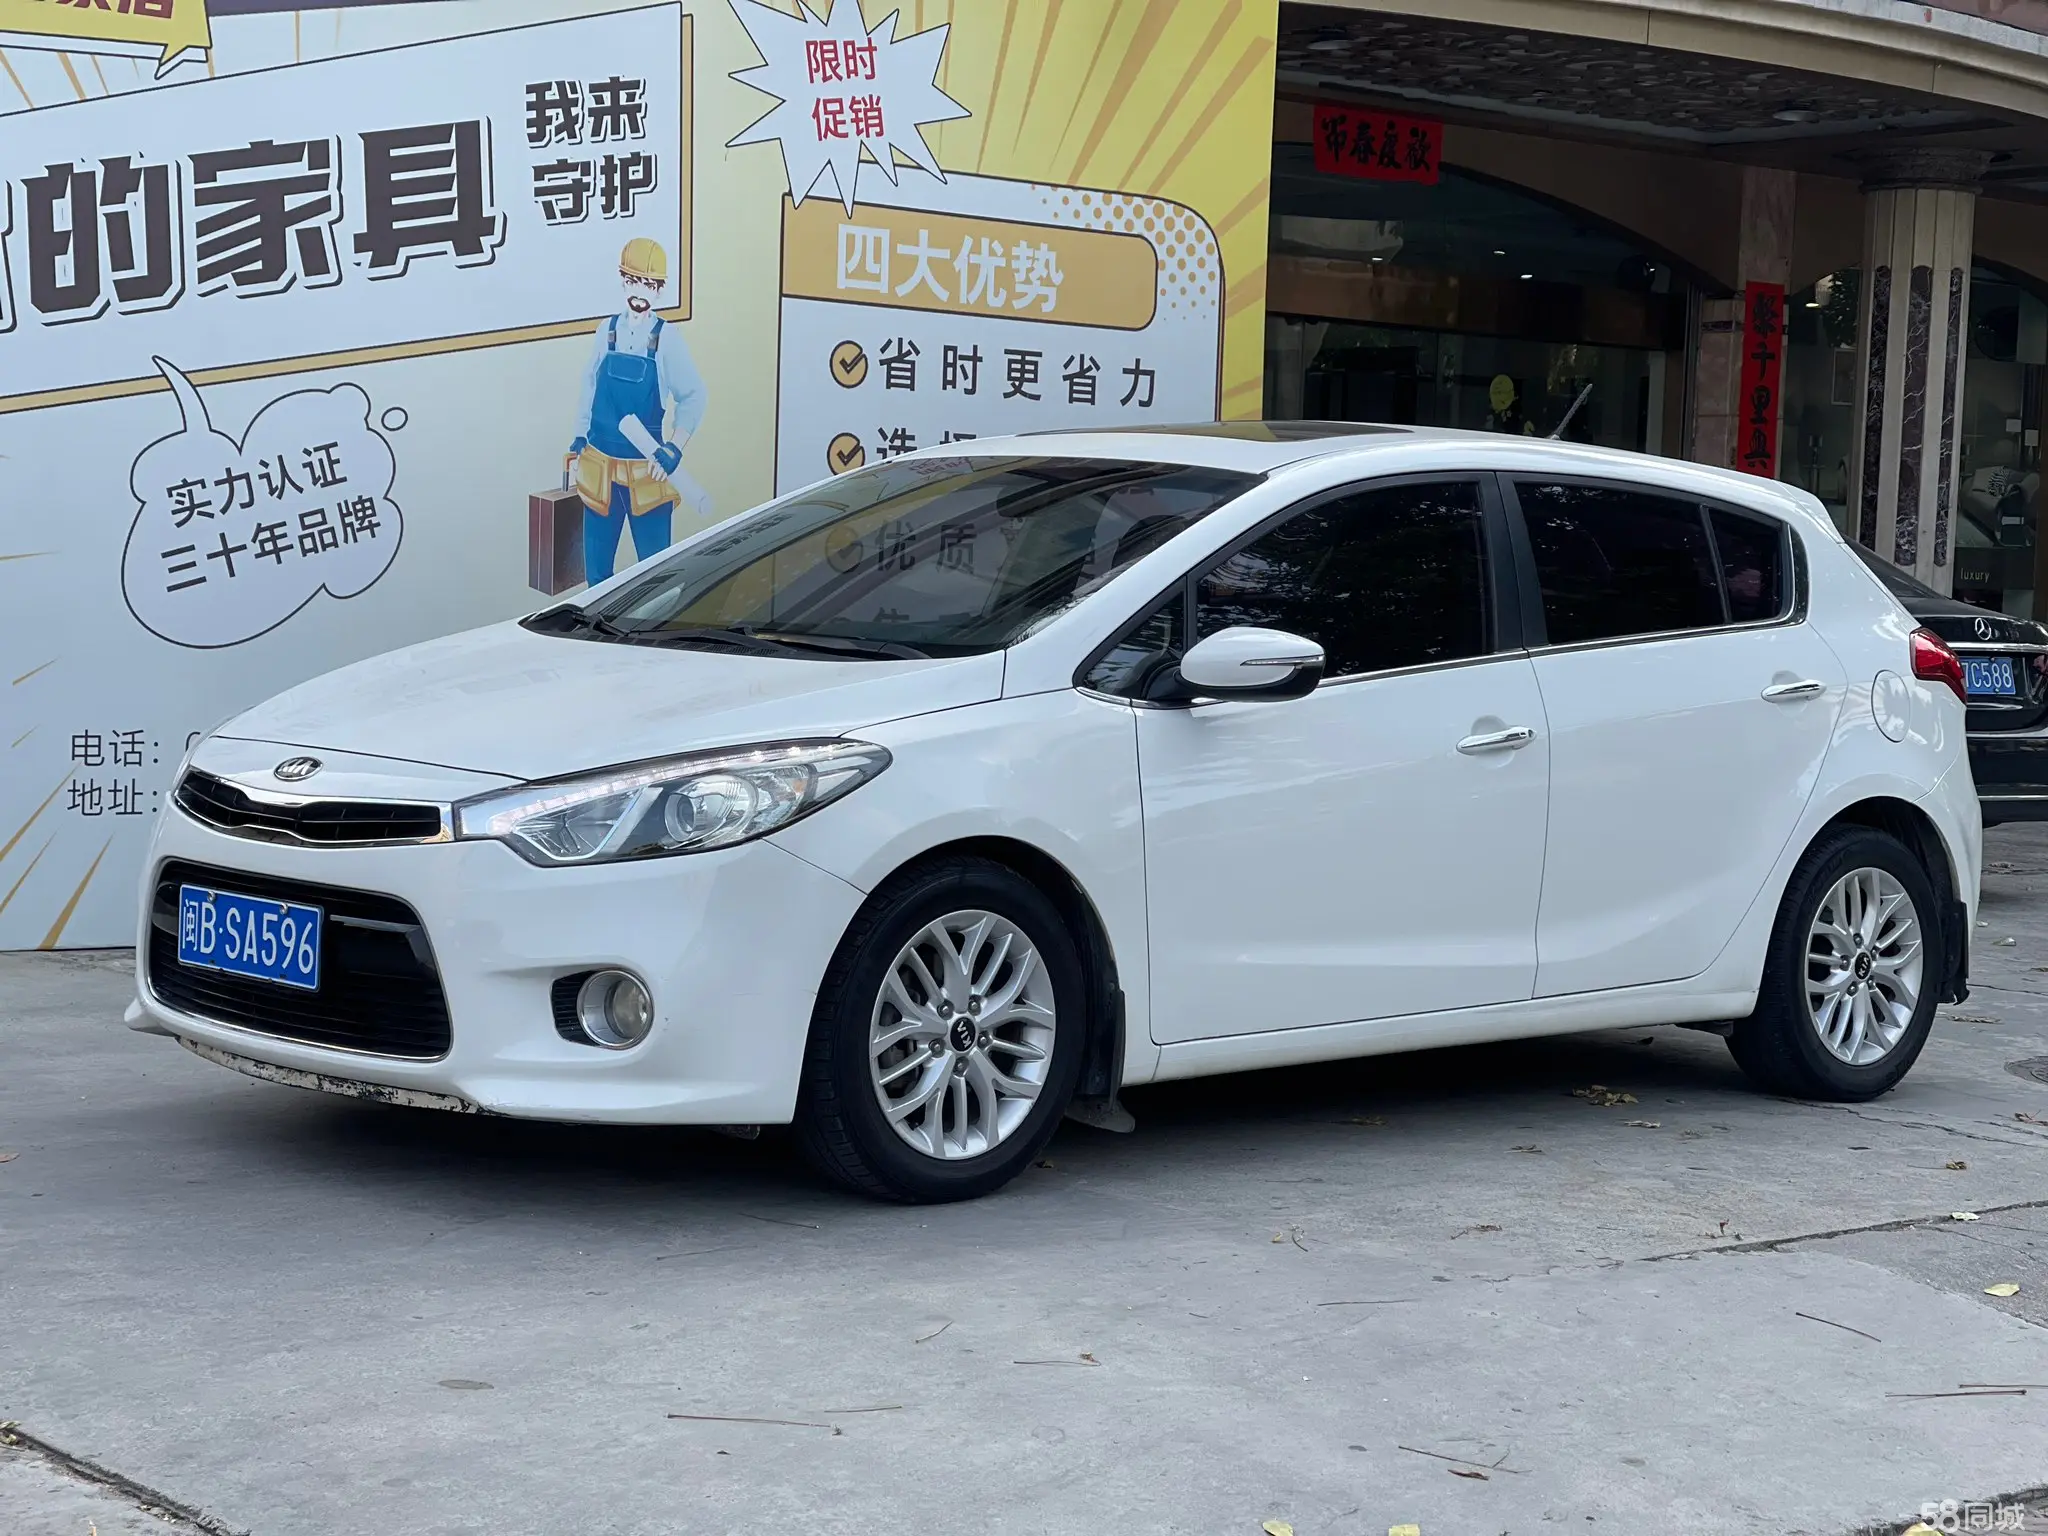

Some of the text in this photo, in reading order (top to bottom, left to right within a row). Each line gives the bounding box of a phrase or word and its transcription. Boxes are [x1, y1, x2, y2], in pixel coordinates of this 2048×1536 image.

[806, 37, 878, 84] 限时
[525, 75, 646, 146] 我来
[811, 95, 886, 141] 促销
[0, 118, 503, 325] 的家具
[532, 151, 656, 223] 守护
[836, 223, 1064, 313] 四大优势
[878, 337, 1157, 408] 省时更省力
[166, 441, 348, 528] 实力认证
[161, 495, 382, 593] 三十年品牌
[875, 520, 977, 575] 优质
[1960, 567, 1990, 583] luxury
[181, 898, 316, 975] 闽B·SA596
[955, 1020, 973, 1049] KIA
